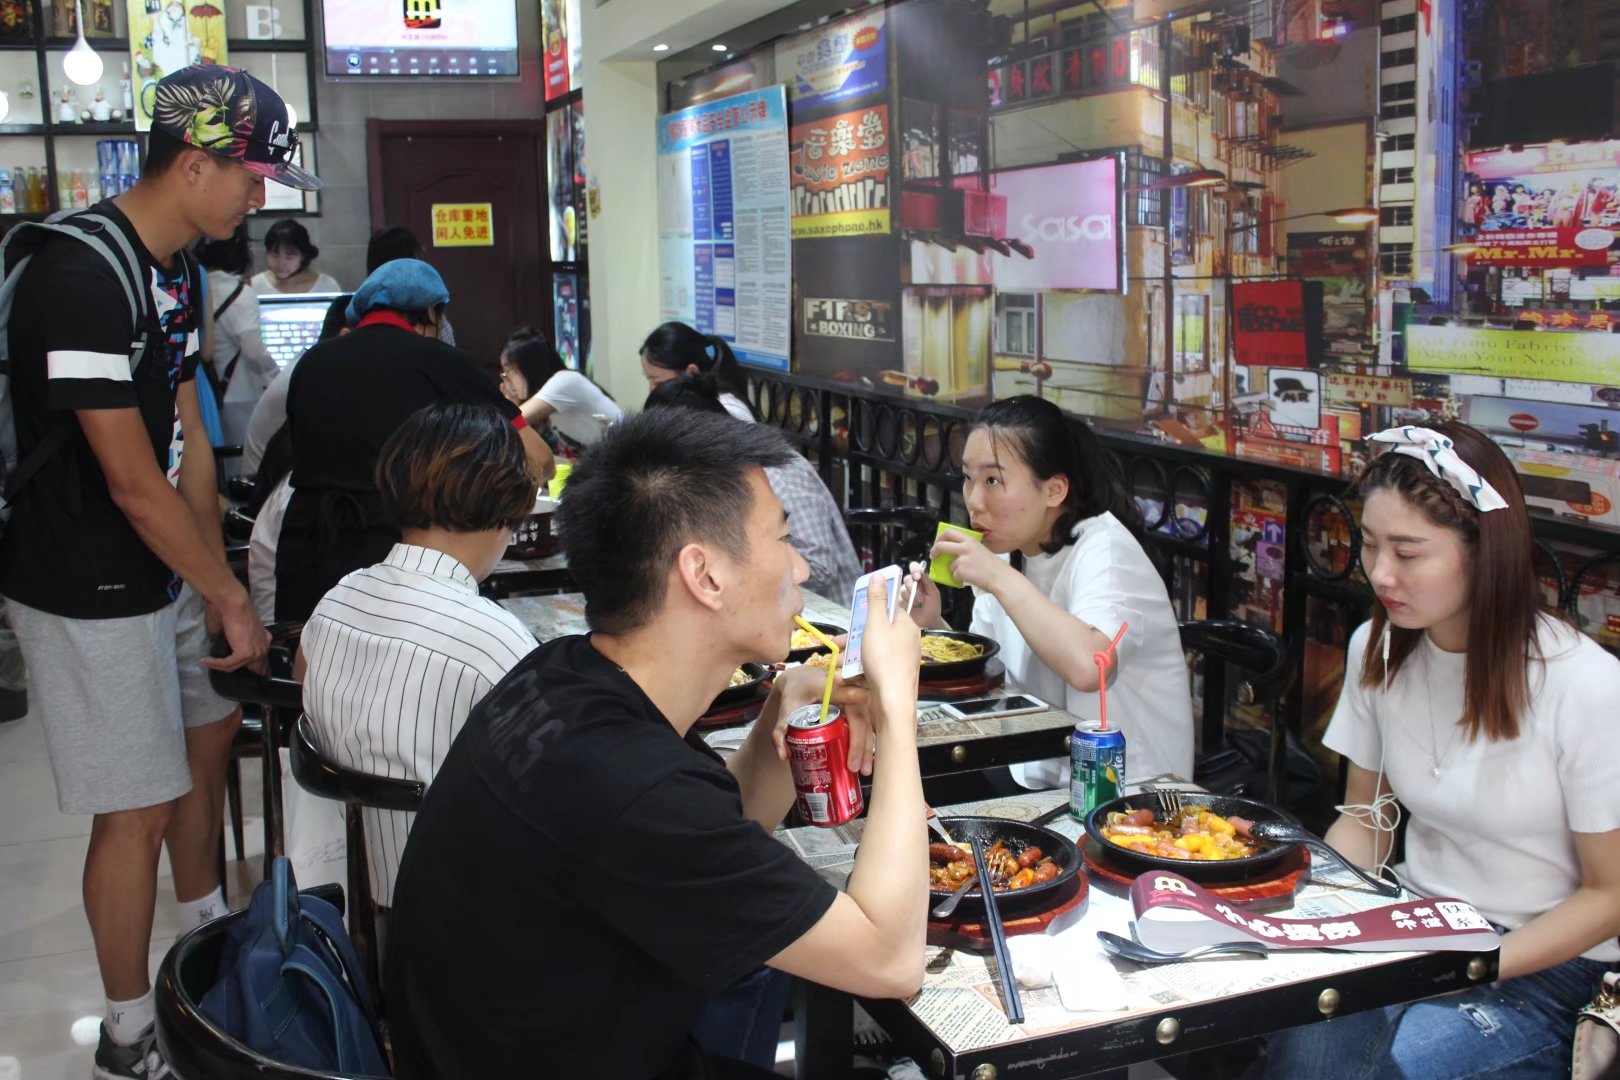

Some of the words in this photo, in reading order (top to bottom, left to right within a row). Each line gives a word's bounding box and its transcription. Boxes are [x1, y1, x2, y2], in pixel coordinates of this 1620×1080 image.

[246, 5, 283, 40] B
[436, 208, 488, 223] 仓库重地
[437, 225, 488, 240] 闲人免进
[819, 321, 876, 338] BOXING
[1505, 339, 1577, 353] Fabric
[1522, 353, 1579, 368] Need
